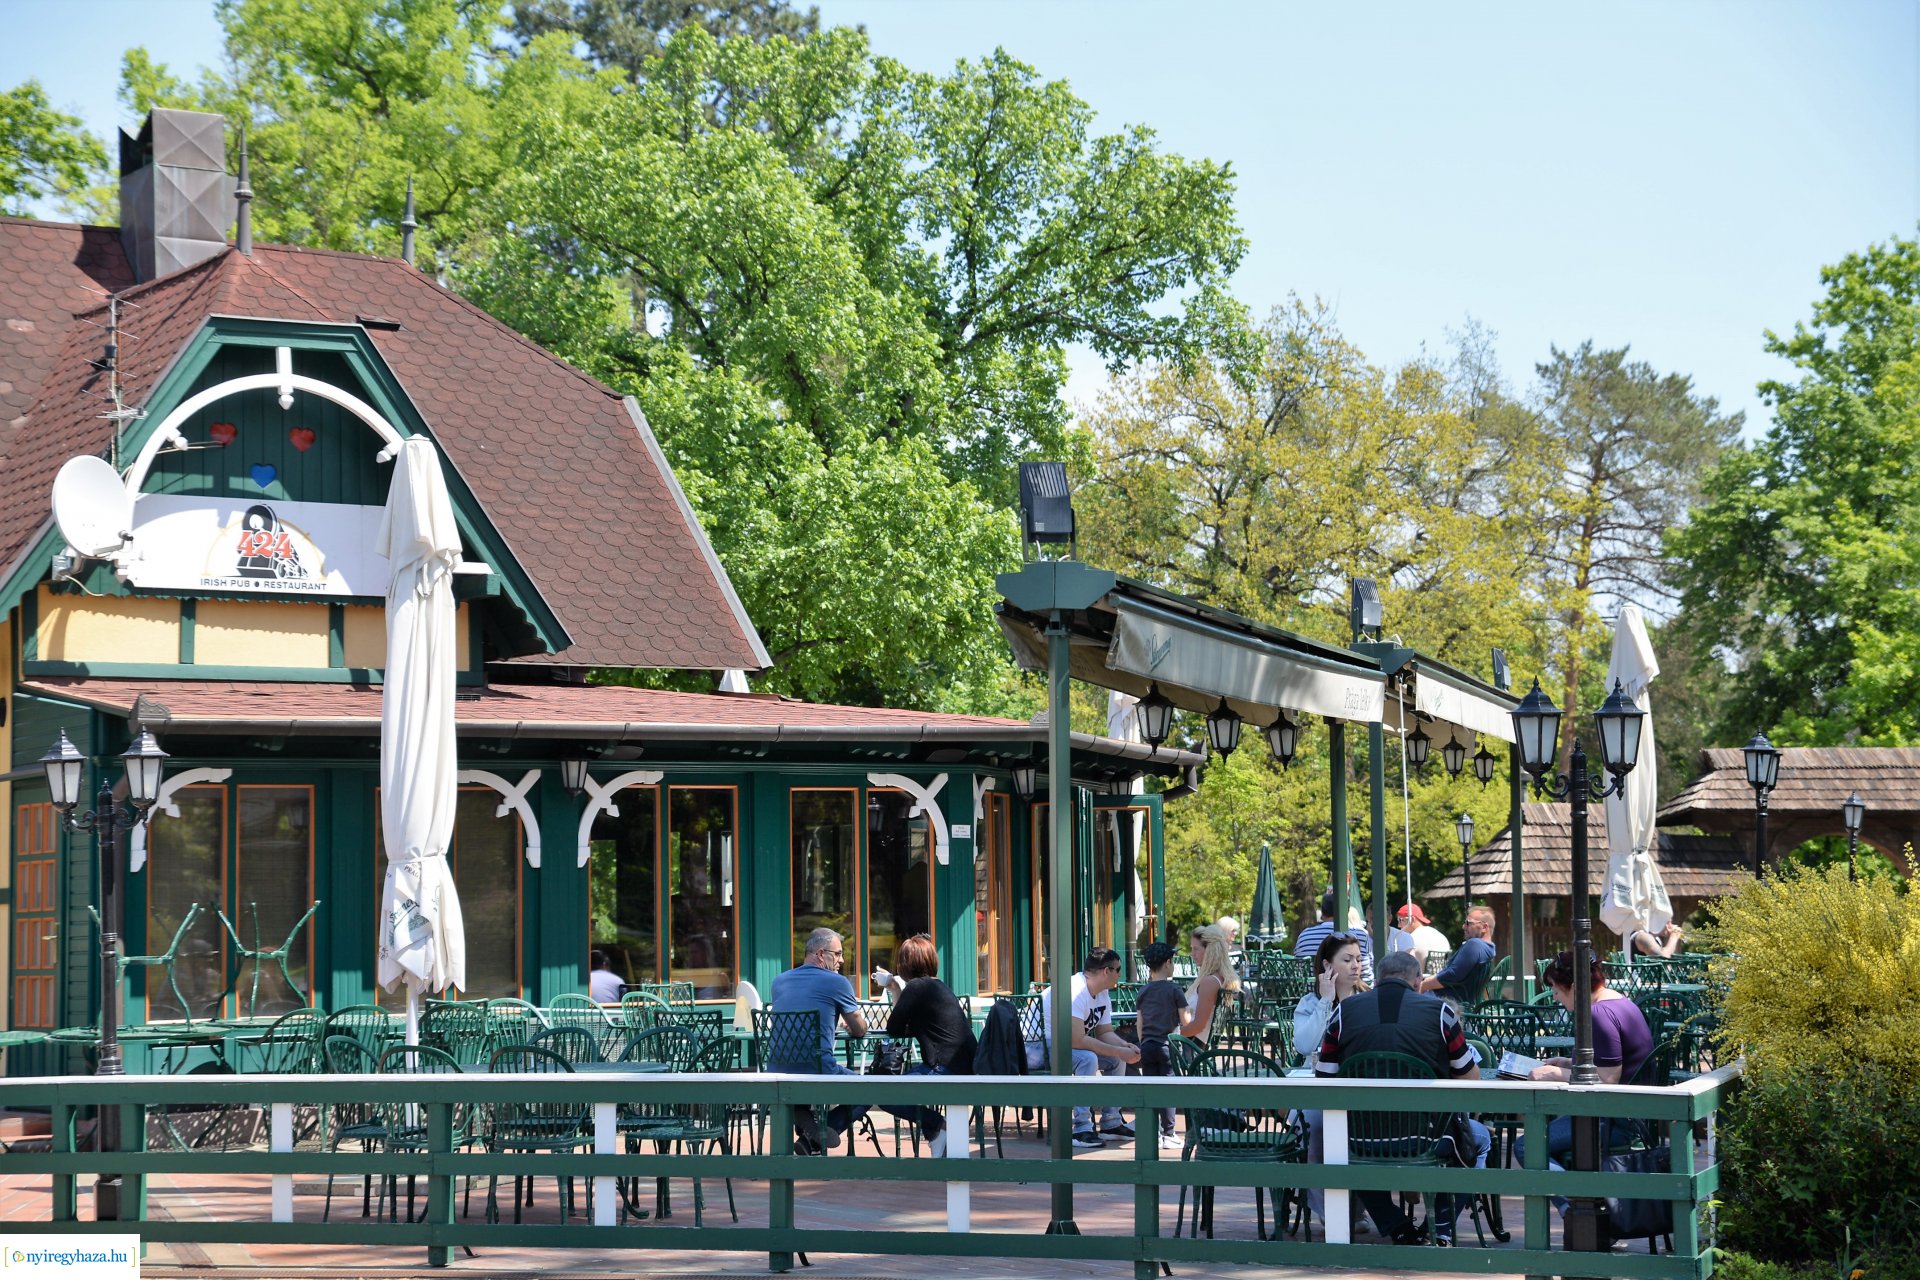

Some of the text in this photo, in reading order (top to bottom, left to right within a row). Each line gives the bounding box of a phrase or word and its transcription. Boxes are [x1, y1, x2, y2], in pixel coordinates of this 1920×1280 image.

[237, 531, 293, 559] 424
[200, 578, 327, 591] IRISH PUB RESTAURANT
